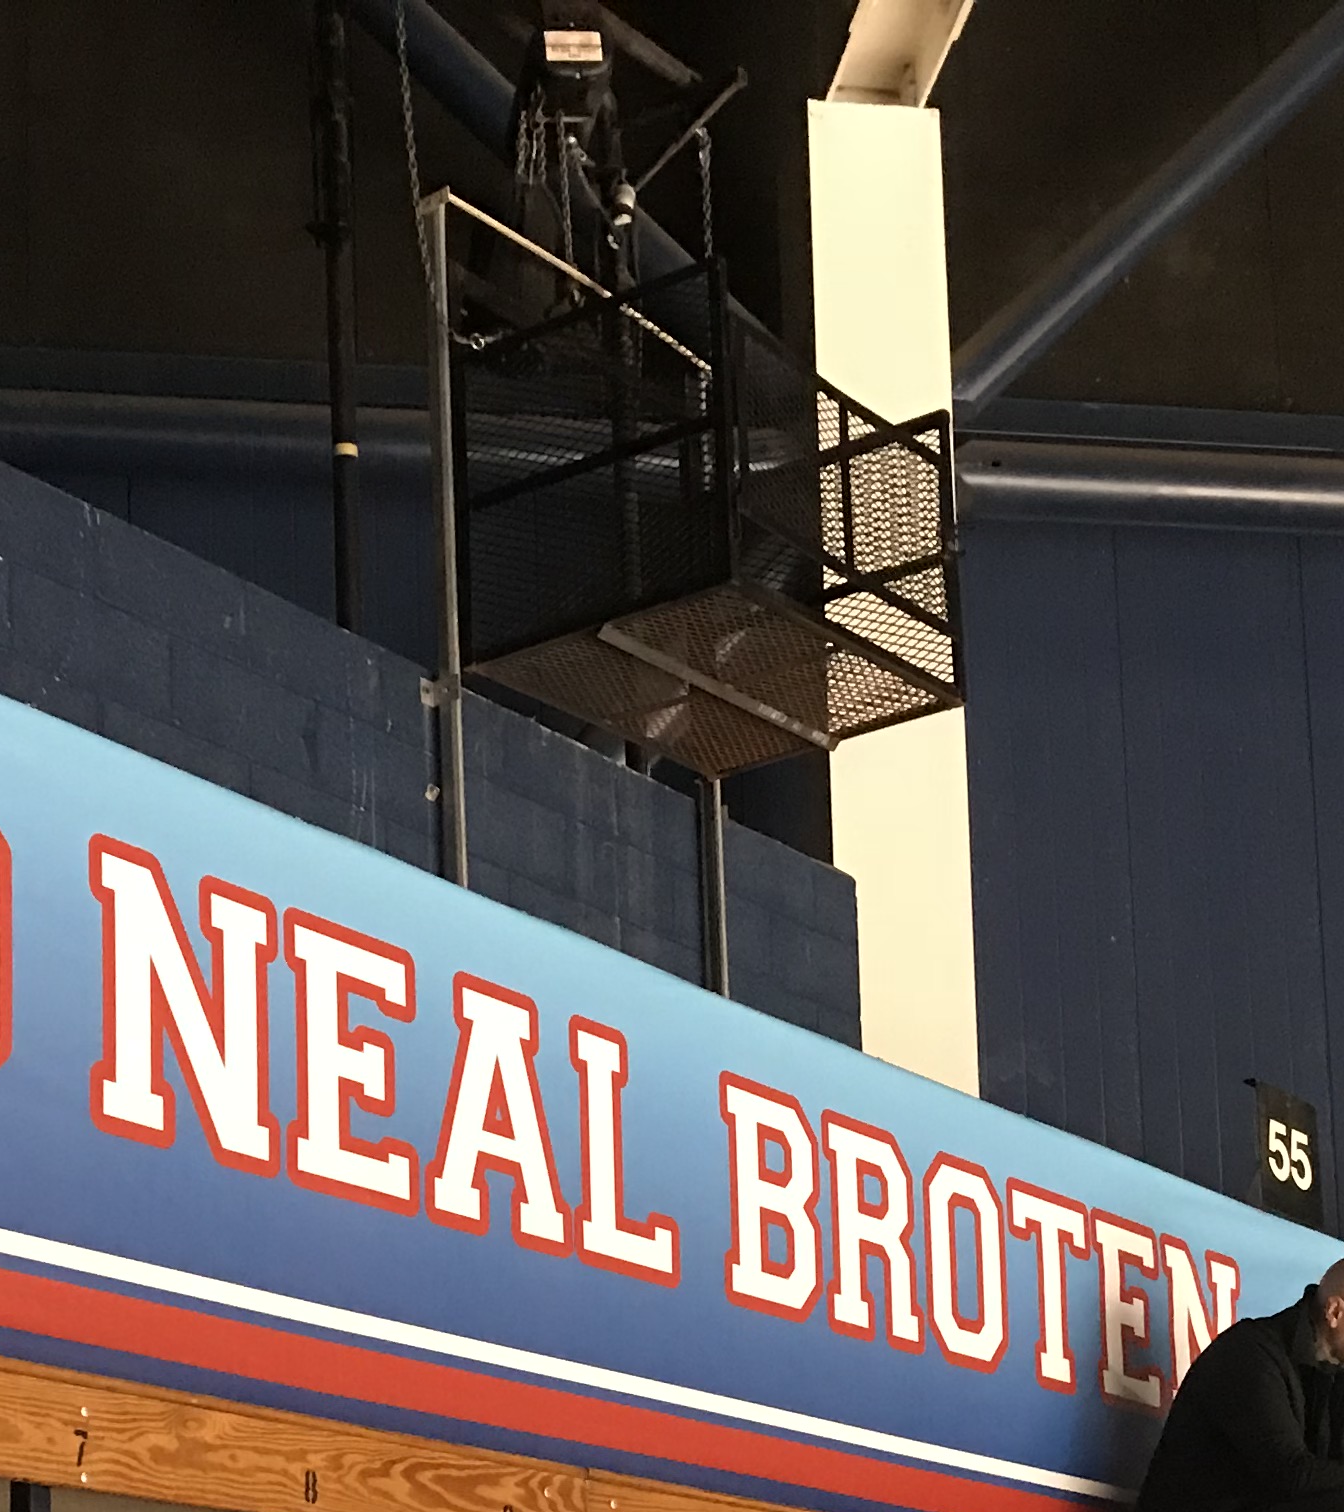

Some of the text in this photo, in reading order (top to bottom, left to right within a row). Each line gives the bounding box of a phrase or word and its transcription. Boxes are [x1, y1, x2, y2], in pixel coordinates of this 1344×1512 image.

[89, 833, 681, 1288] NEAL
[719, 1070, 1240, 1416] BROTEN
[1268, 1118, 1313, 1191] 55
[73, 1428, 89, 1468] 7
[303, 1468, 319, 1505] 8
